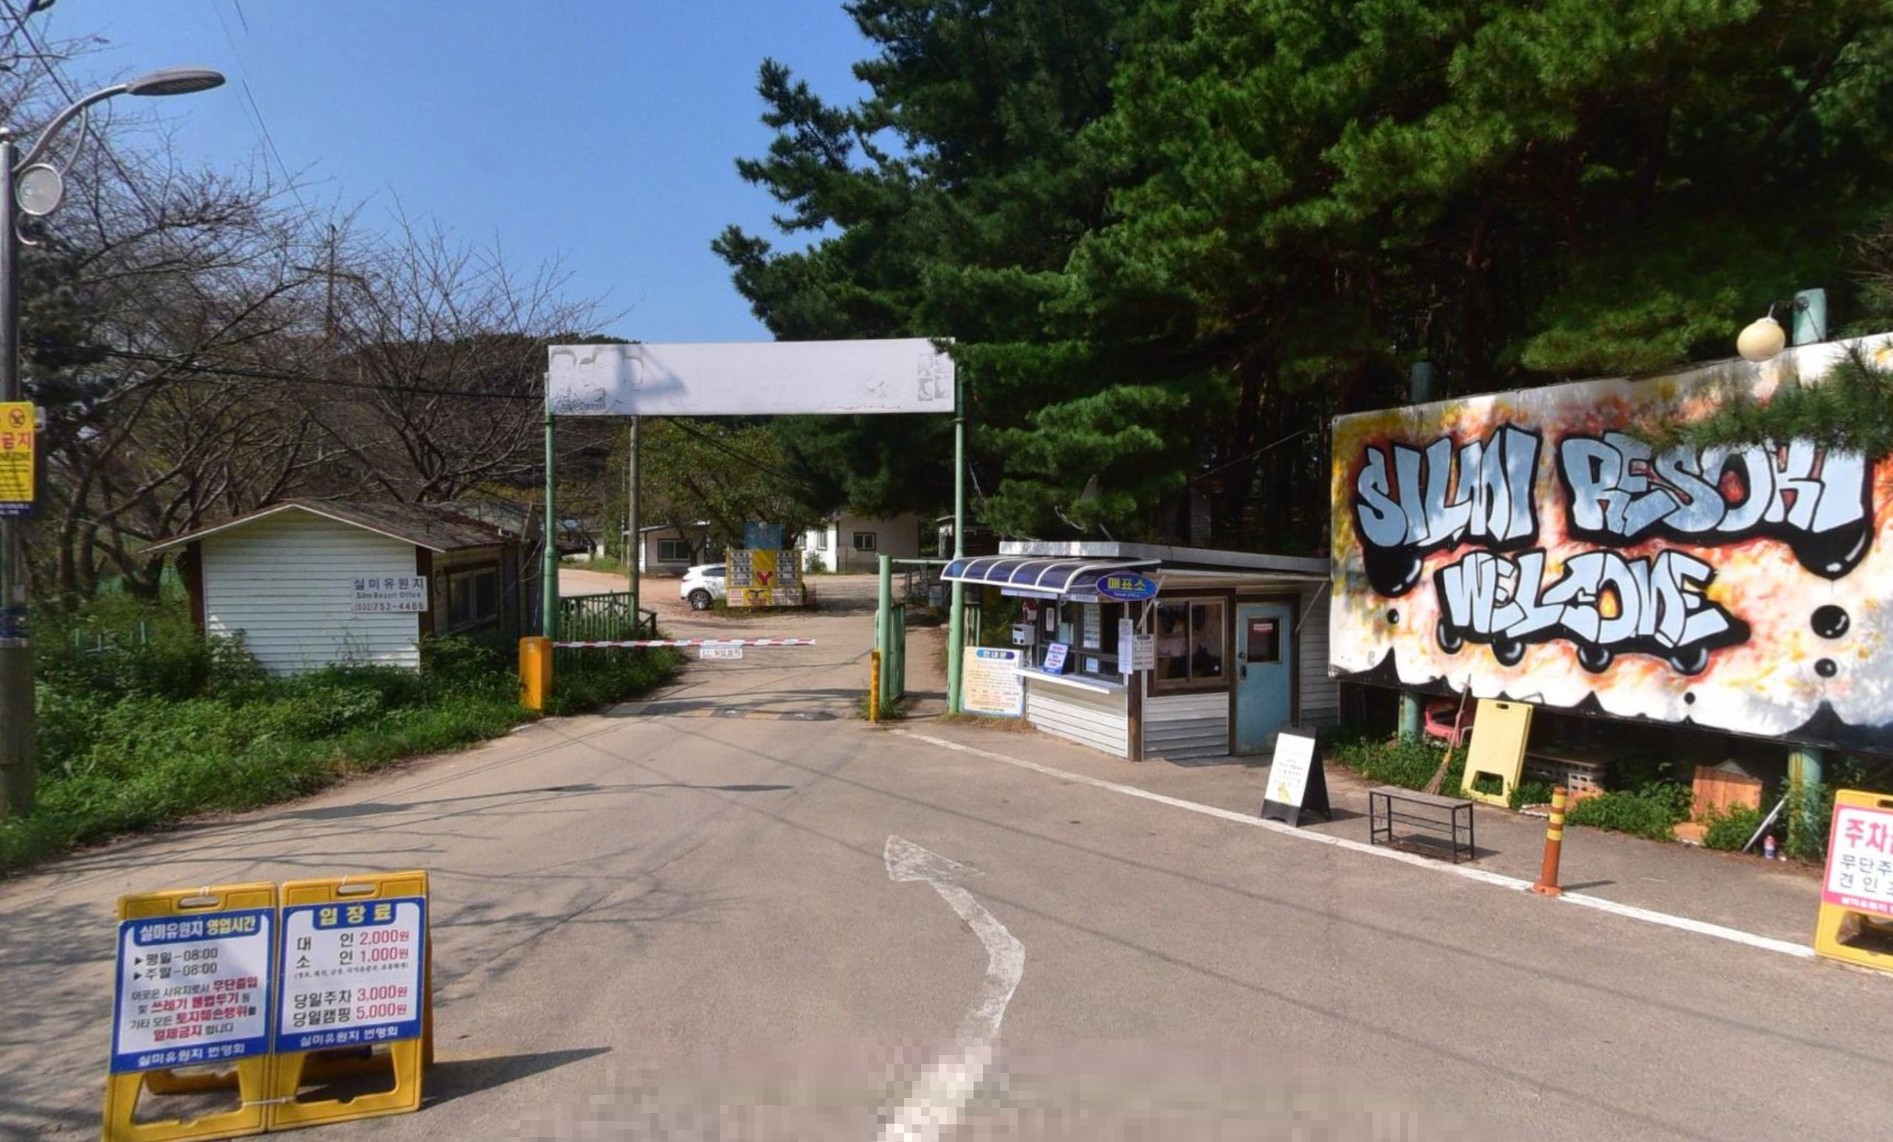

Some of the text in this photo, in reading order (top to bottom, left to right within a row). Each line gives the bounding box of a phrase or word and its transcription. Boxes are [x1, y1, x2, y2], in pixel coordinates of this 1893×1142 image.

[1355, 424, 1541, 548] SILMI
[354, 578, 424, 590] 실미유원지
[1108, 576, 1146, 591] 매표소
[1439, 549, 1728, 649] WELCOME
[1845, 817, 1893, 855] 주차
[319, 903, 392, 926] 입장료
[140, 915, 256, 942] 실미유원지 영업시간
[297, 936, 312, 951] 대
[340, 933, 354, 948] 인
[296, 954, 311, 969] 소
[340, 951, 354, 966] 인
[131, 977, 258, 1000] 이곳은 사유지로서 무단출입
[294, 989, 351, 1009] 당일주차
[151, 998, 187, 1013] 쓰레기
[192, 992, 239, 1009] 불법투기
[131, 1019, 149, 1030] 기타
[152, 1015, 173, 1027] 모든
[293, 1007, 351, 1028] 당일캠핑
[153, 1022, 234, 1042] 일체금지 합니다
[300, 1026, 399, 1048] 실미유원지 번영회
[138, 1043, 245, 1067] 실미유원지 번영회
